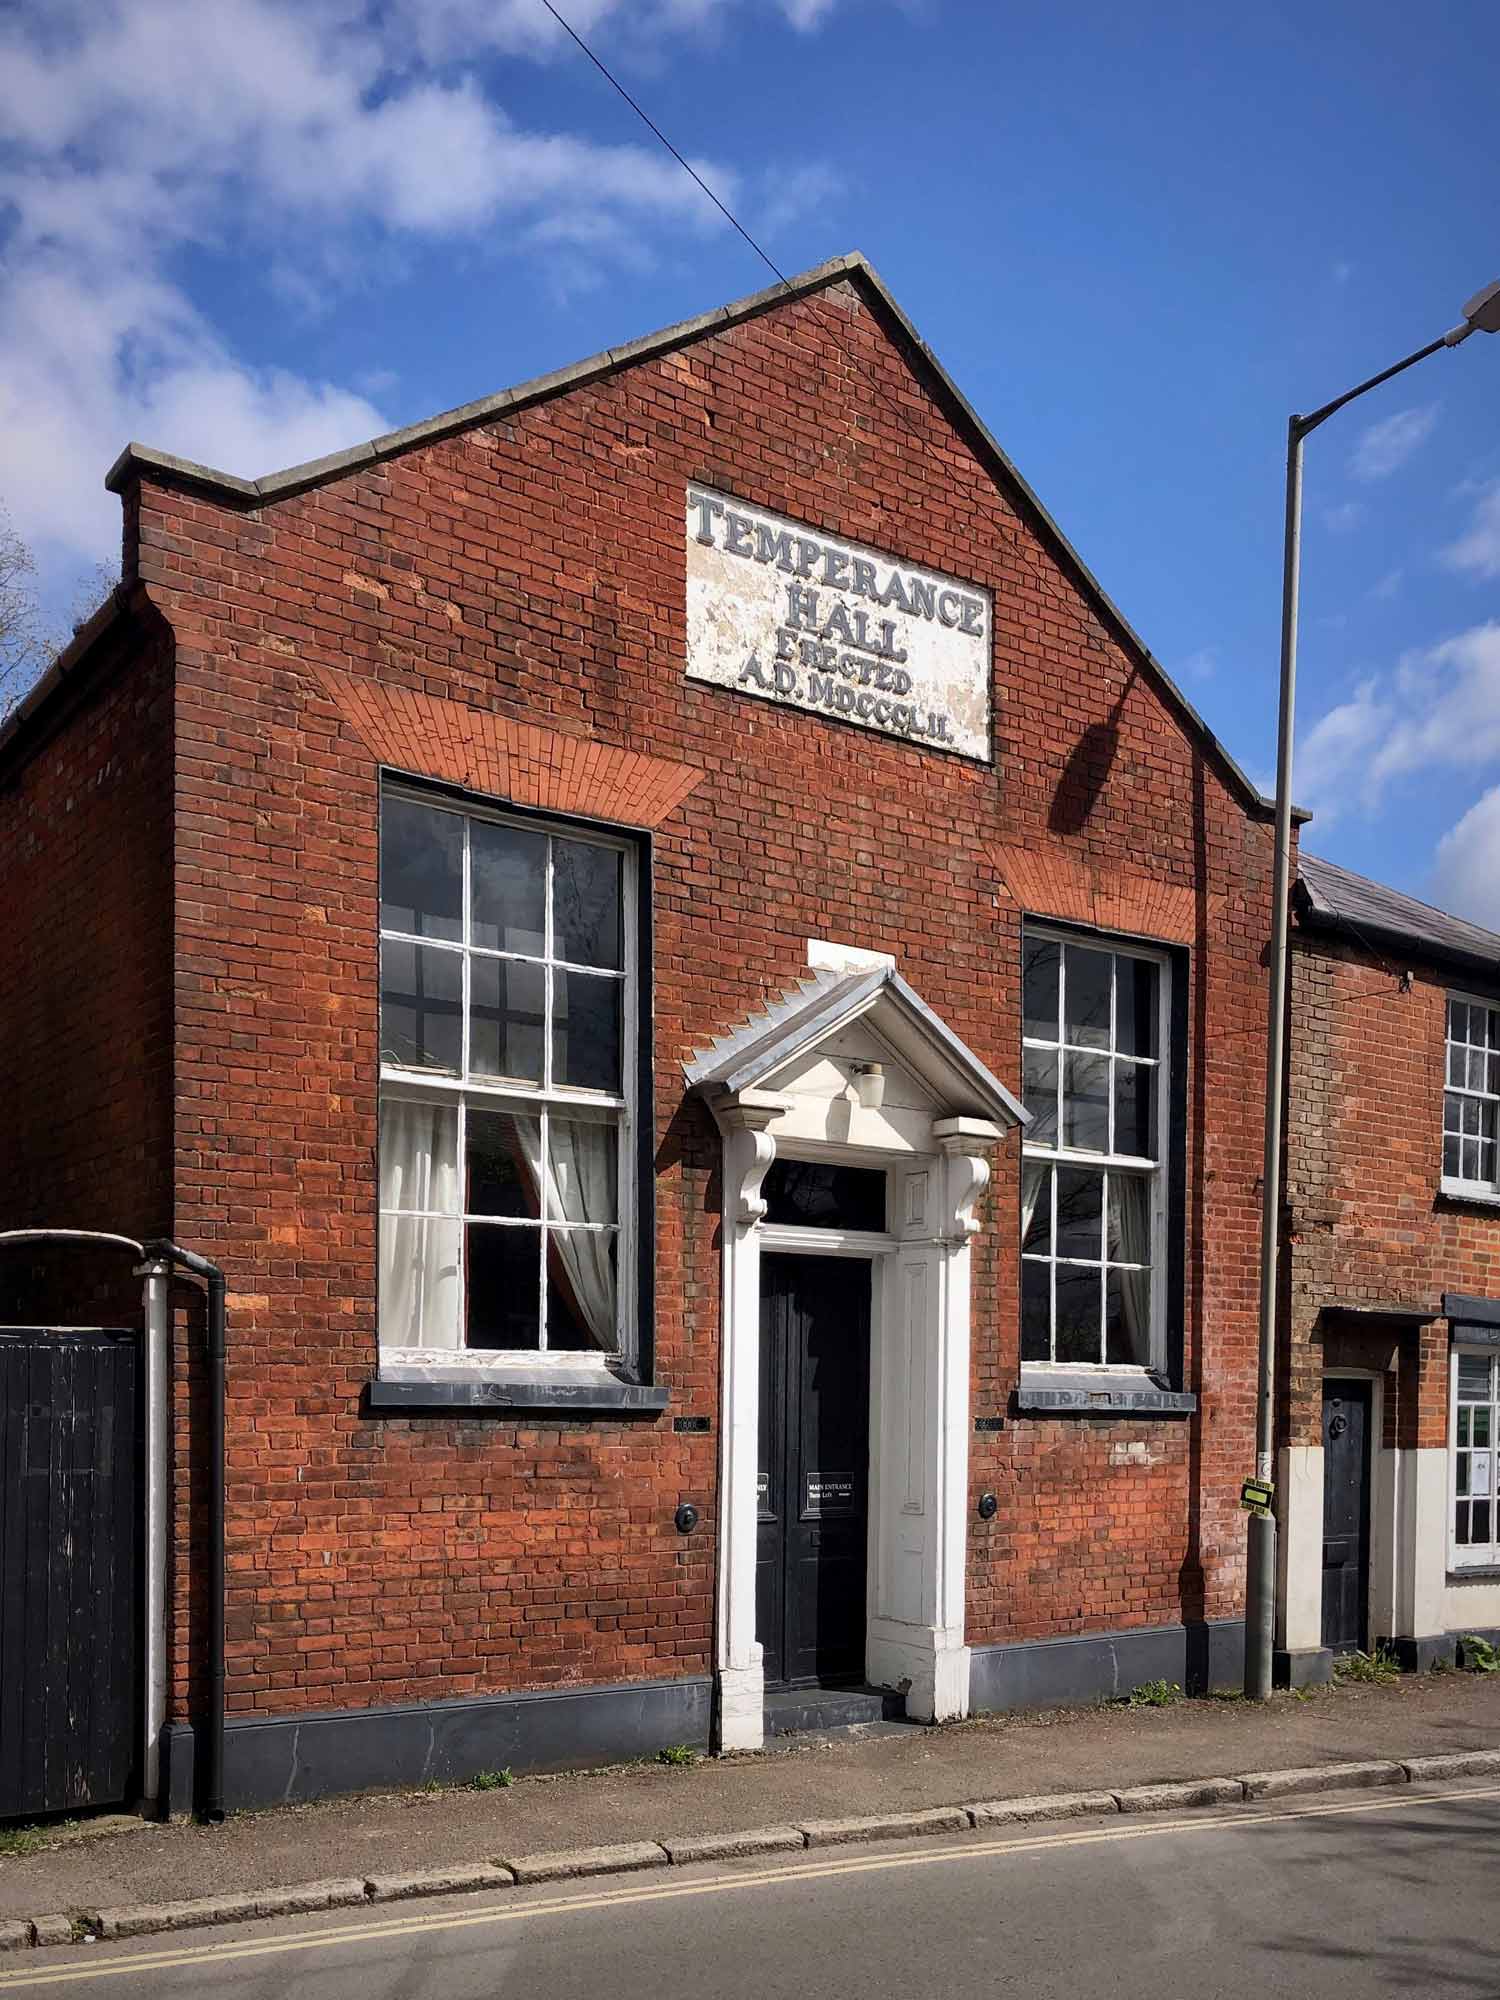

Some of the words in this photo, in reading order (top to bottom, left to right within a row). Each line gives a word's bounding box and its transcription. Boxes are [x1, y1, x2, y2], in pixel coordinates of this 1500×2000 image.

[689, 491, 984, 637] TEMPERANCE
[775, 626, 912, 696] ERECTED
[785, 583, 908, 664] HALL
